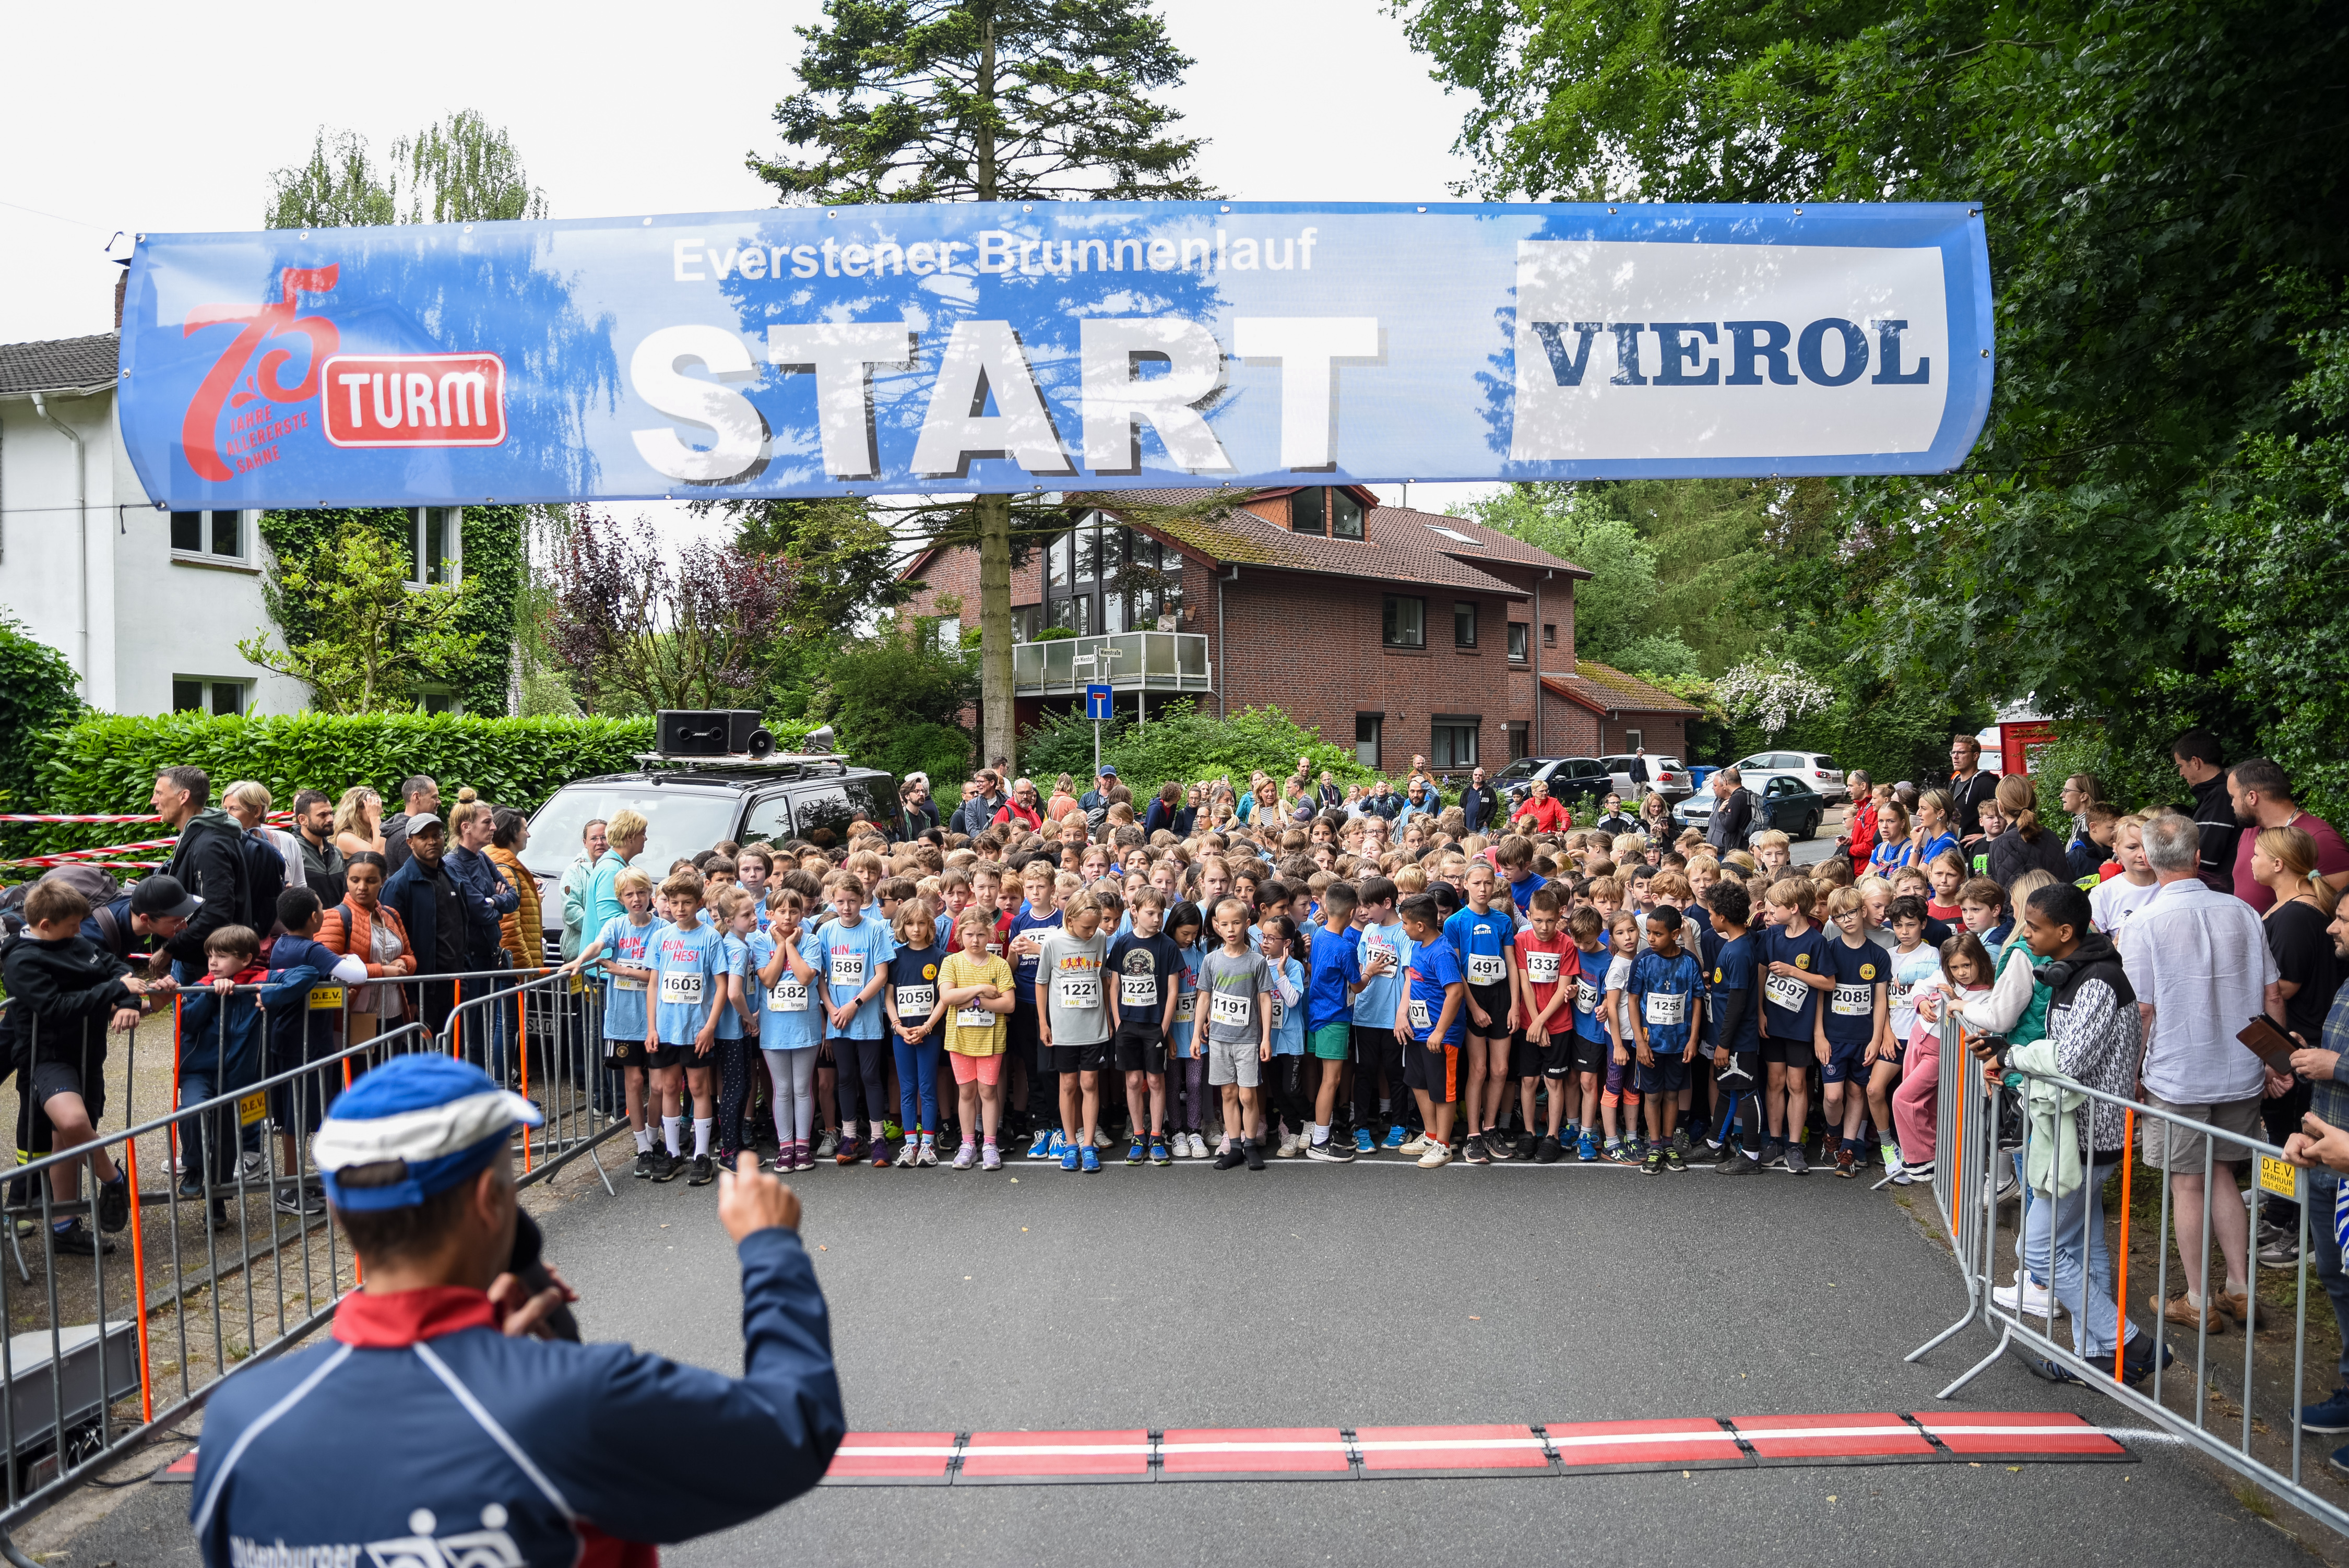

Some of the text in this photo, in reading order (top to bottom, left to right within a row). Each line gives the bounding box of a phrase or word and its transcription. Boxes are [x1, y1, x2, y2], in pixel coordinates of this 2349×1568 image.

[672, 227, 1319, 282] Everstener Brunnenlauf
[1531, 317, 1930, 387] VIEROL
[338, 372, 488, 429] TURM
[630, 316, 1384, 484] START
[230, 405, 272, 435] JAHRE
[226, 411, 309, 457] ALLERERSTE
[236, 447, 281, 473] SAHNE
[619, 936, 641, 949] RUN
[662, 940, 685, 951] RUN
[673, 951, 699, 962] HES!
[1128, 950, 1151, 958] DENMARK
[832, 960, 862, 973] 1589
[1473, 961, 1499, 973] 491
[1527, 957, 1560, 971] 1332
[664, 978, 701, 991] 1603
[1063, 983, 1097, 995] 1221
[1122, 981, 1155, 994] 1222
[1766, 975, 1807, 1000] 2097
[312, 991, 341, 1000] D.E.V.
[768, 987, 806, 999] 1582
[898, 990, 933, 1004] 2059
[1766, 990, 1798, 1008] EWE bruns
[1833, 989, 1870, 1003] 2085
[1214, 998, 1247, 1015] 1191
[1580, 1002, 1591, 1011] bruns
[1654, 1001, 1680, 1011] 1255
[1213, 1013, 1226, 1021] EWE
[242, 1097, 265, 1114] D.E.V.
[2262, 1158, 2293, 1179] D.E.V.
[2262, 1170, 2293, 1188] VERHUUR
[2261, 1179, 2293, 1195] 0591-622611
